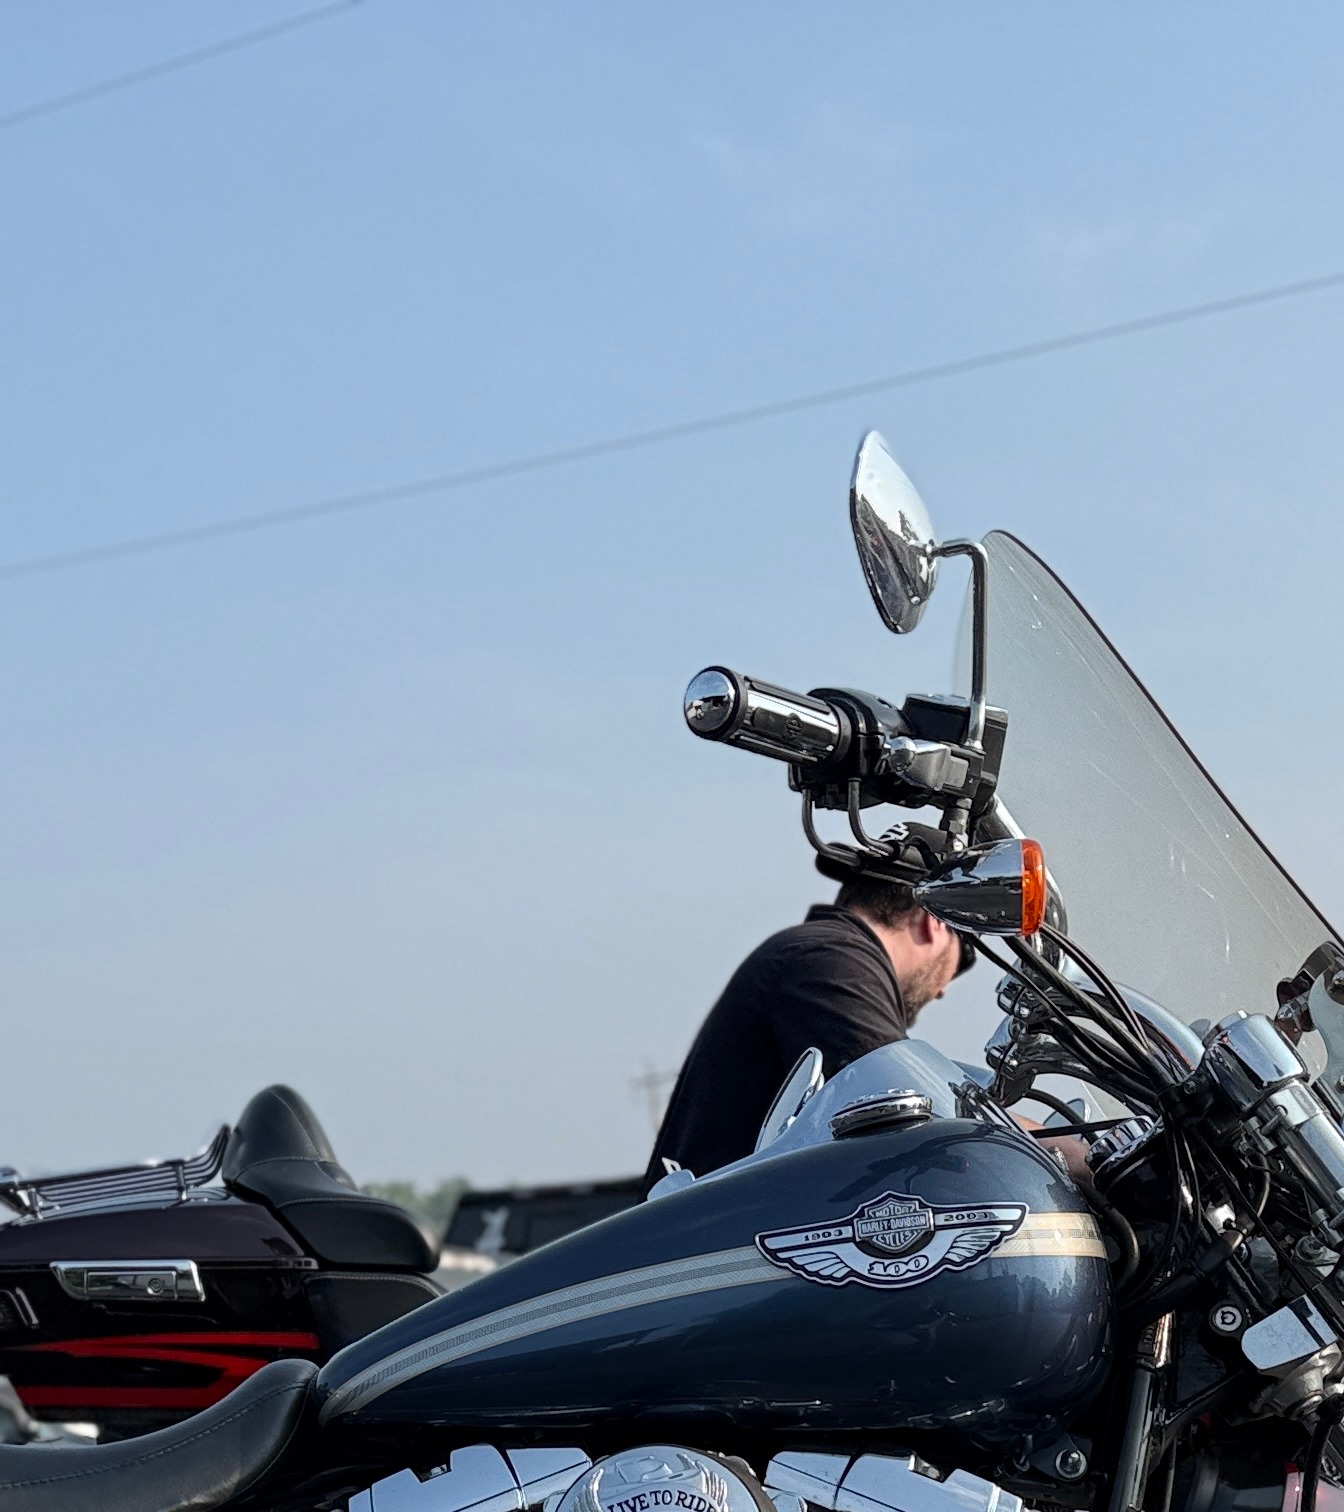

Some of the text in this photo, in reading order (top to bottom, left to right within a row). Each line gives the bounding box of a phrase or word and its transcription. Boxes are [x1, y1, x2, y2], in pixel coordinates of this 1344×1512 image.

[875, 1204, 909, 1218] MOTOR
[943, 1211, 989, 1223] 2003
[861, 1215, 926, 1234] HARLEY-DAVIDSON
[803, 1229, 844, 1242] 1903
[877, 1230, 912, 1247] CYCLES
[867, 1254, 929, 1276] 100
[649, 1489, 673, 1506] TO
